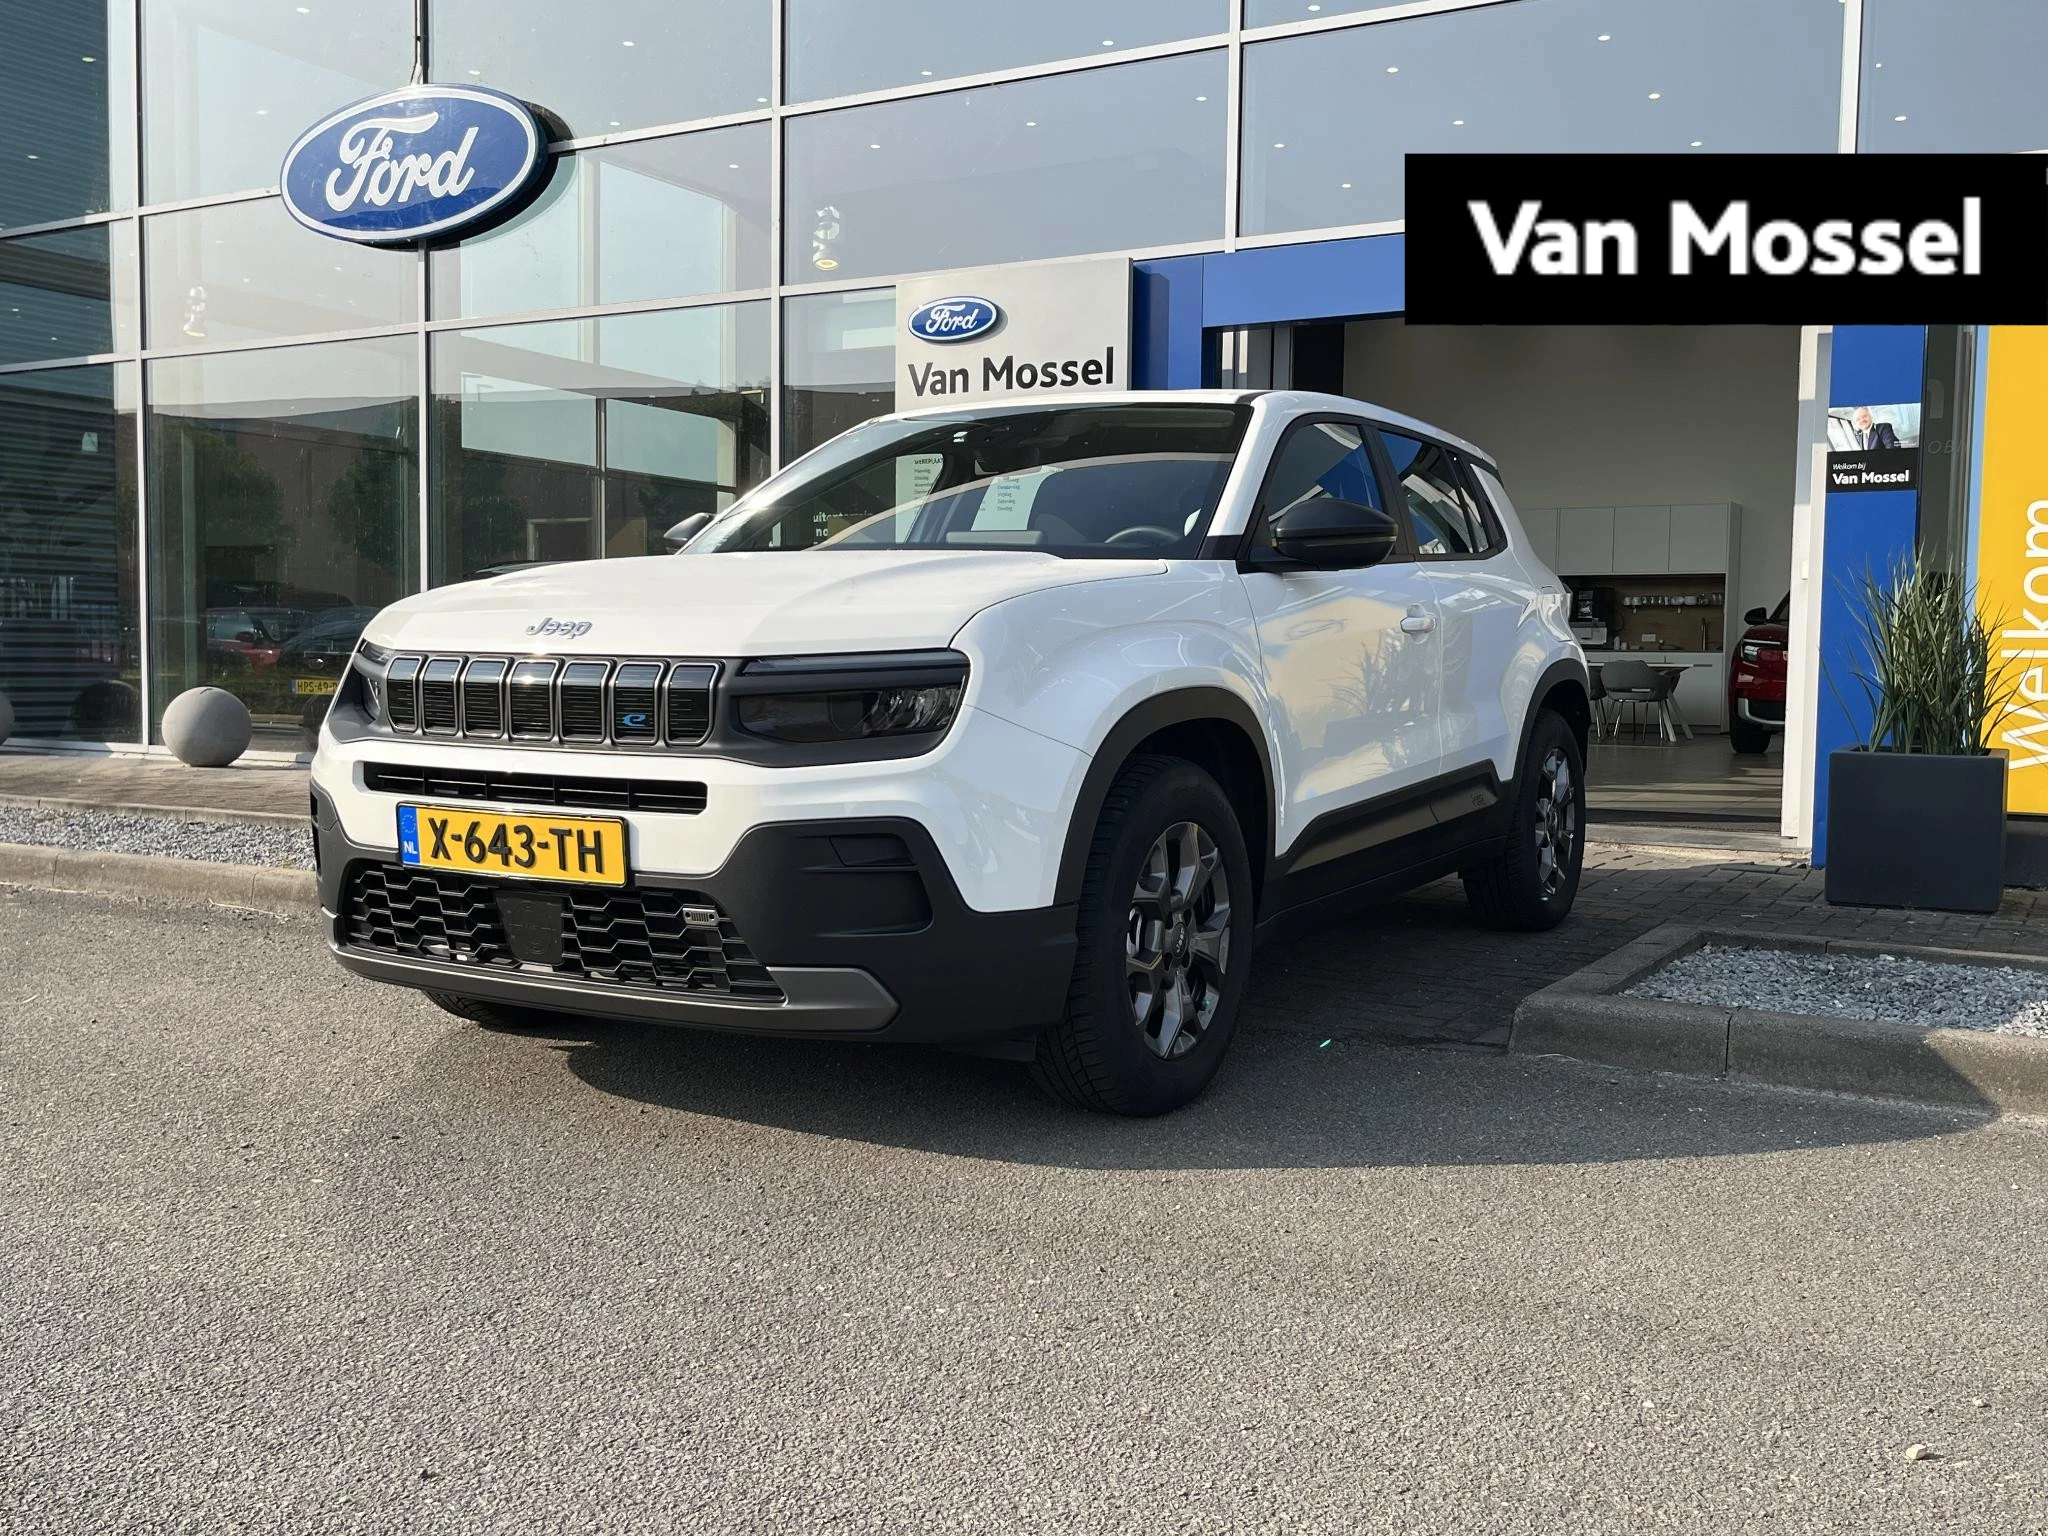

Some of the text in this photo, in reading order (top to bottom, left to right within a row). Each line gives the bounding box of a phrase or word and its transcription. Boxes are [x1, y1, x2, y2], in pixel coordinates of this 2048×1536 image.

[326, 111, 479, 212] Ford
[925, 303, 980, 334] Ford
[907, 346, 1114, 397] Van Mossel
[1832, 462, 1867, 471] Welkom bij
[1832, 470, 1910, 485] Van Mossel
[526, 617, 593, 640] Jeep
[403, 840, 418, 855] NL
[427, 817, 606, 875] X-643-TH
